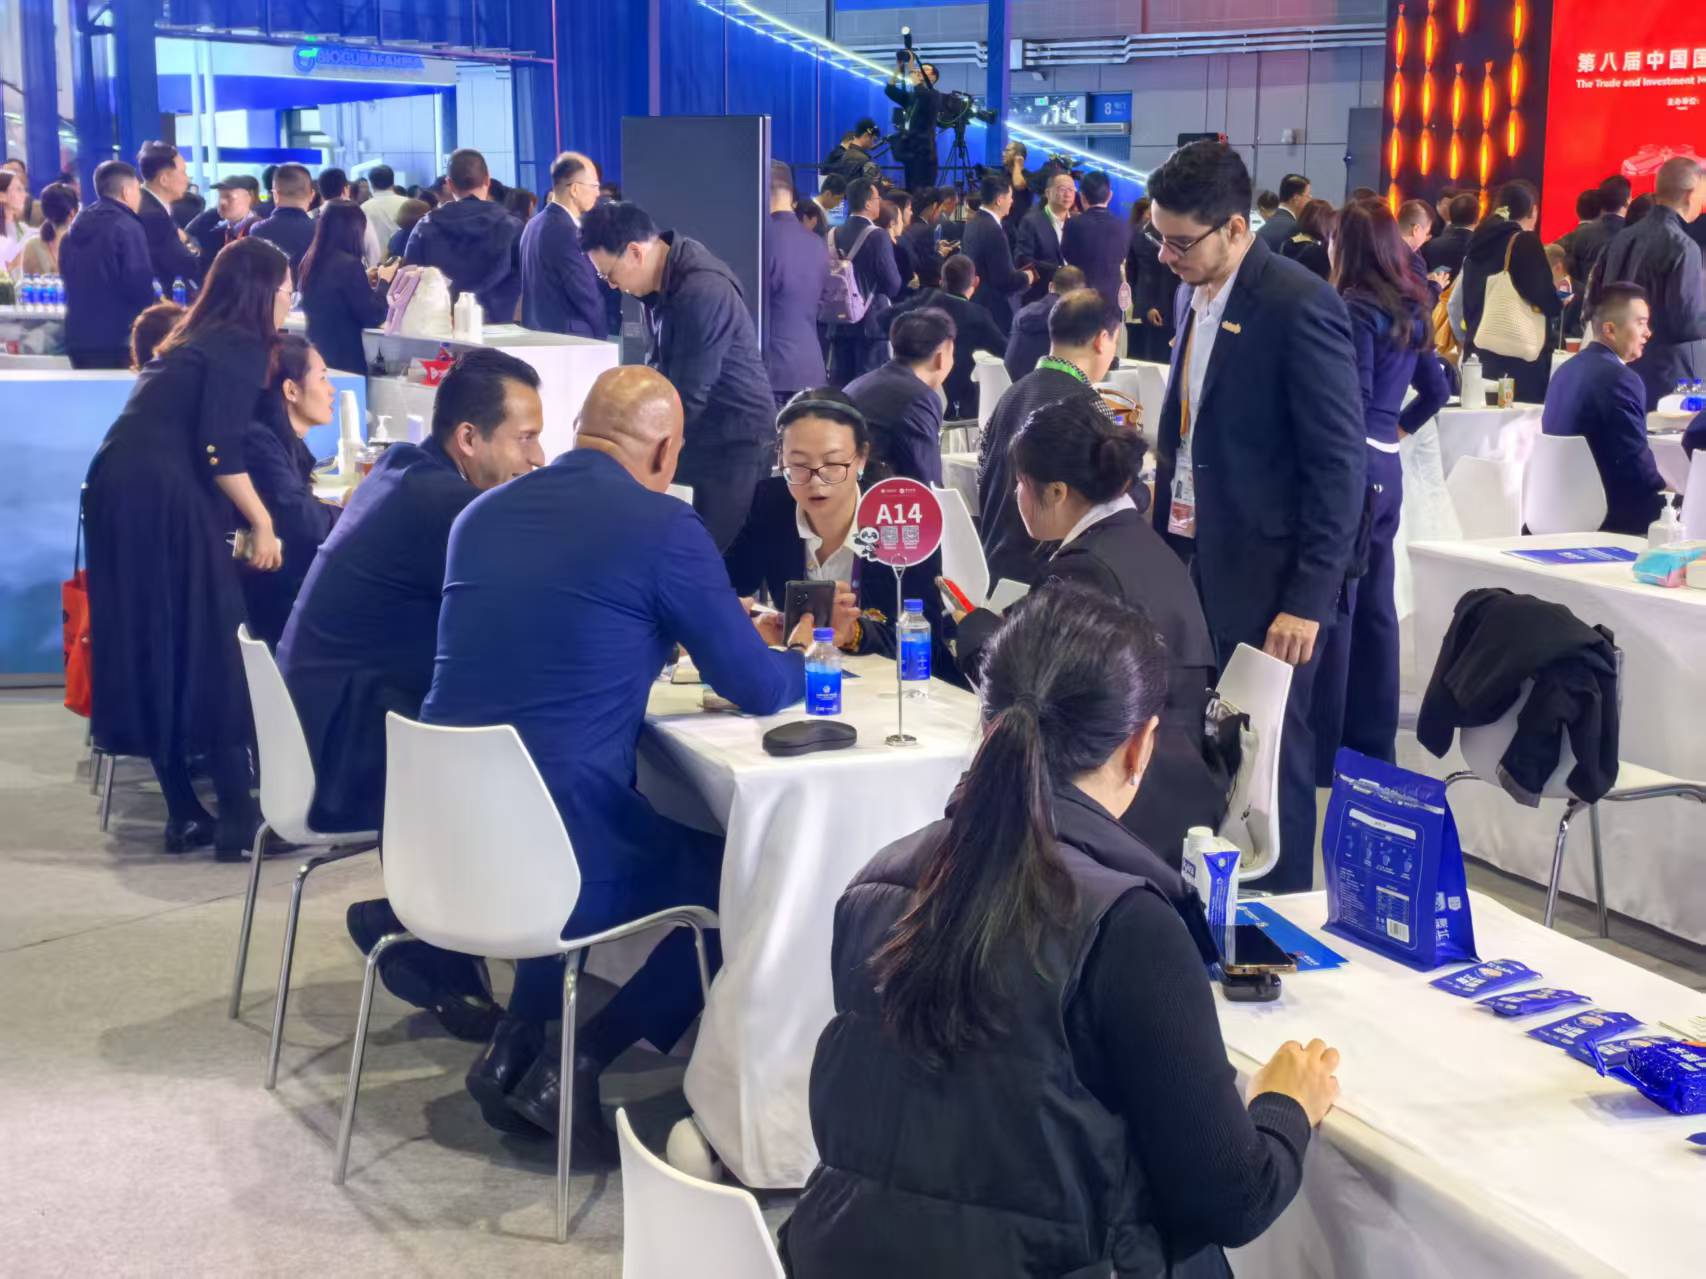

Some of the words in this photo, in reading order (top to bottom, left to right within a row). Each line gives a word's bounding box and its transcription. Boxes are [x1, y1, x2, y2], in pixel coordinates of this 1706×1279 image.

[1576, 79, 1593, 89] The
[1596, 78, 1621, 88] Trade
[1623, 76, 1641, 87] and
[1643, 74, 1695, 86] Investment
[1104, 102, 1112, 115] 8
[876, 503, 922, 525] A14
